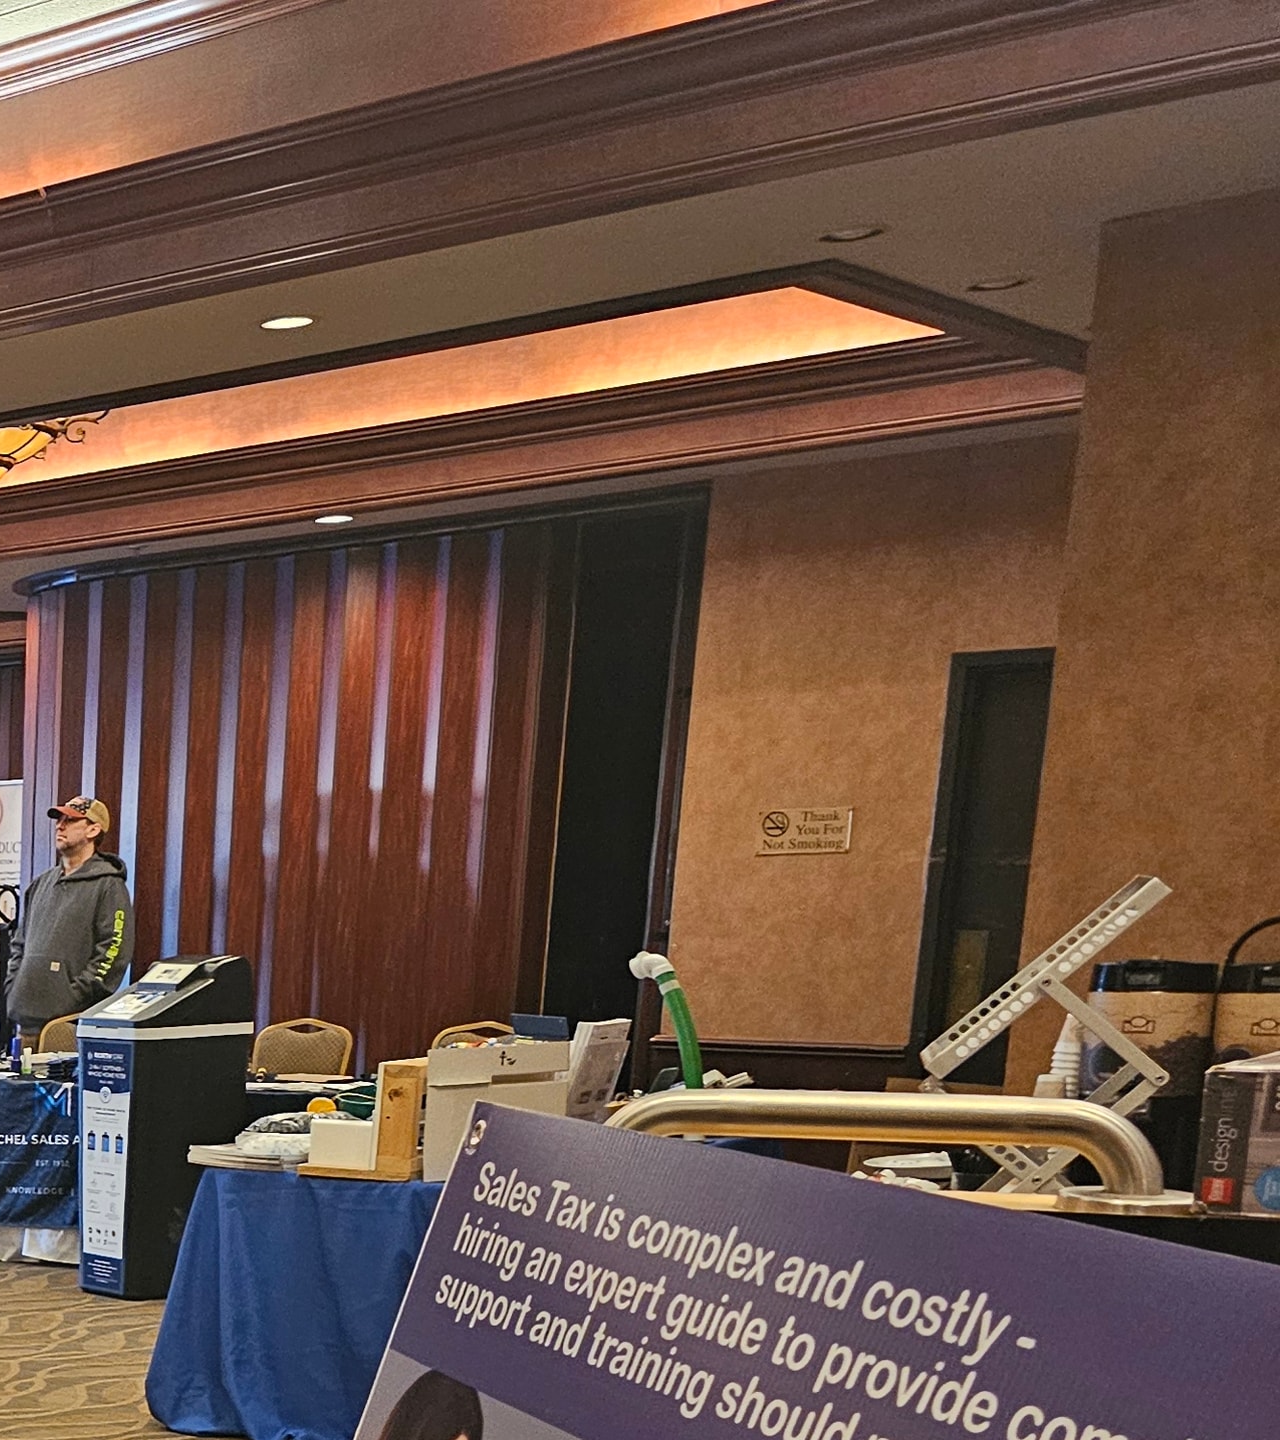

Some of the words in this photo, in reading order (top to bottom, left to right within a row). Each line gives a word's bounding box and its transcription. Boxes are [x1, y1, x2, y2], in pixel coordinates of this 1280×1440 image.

[801, 810, 841, 822] Thank
[796, 824, 819, 836] You
[823, 823, 846, 835] For
[762, 839, 785, 851] Not
[788, 838, 845, 850] Smoking
[95, 910, 125, 981] carhartt
[31, 1134, 70, 1145] SALES
[6, 1186, 64, 1195] KNOWLEDGE
[472, 1160, 541, 1216] Sales
[544, 1179, 596, 1233] Tax
[593, 1193, 625, 1241] is
[626, 1214, 775, 1286] complex
[774, 1255, 864, 1310] and
[861, 1280, 1011, 1365] costly
[452, 1213, 525, 1281] hiring
[524, 1246, 562, 1285] an
[563, 1259, 666, 1320] expert
[659, 1293, 767, 1355] guide
[771, 1315, 815, 1371] to
[811, 1342, 998, 1433] provide
[434, 1273, 532, 1336] support
[528, 1310, 591, 1358] and
[586, 1321, 715, 1419] training
